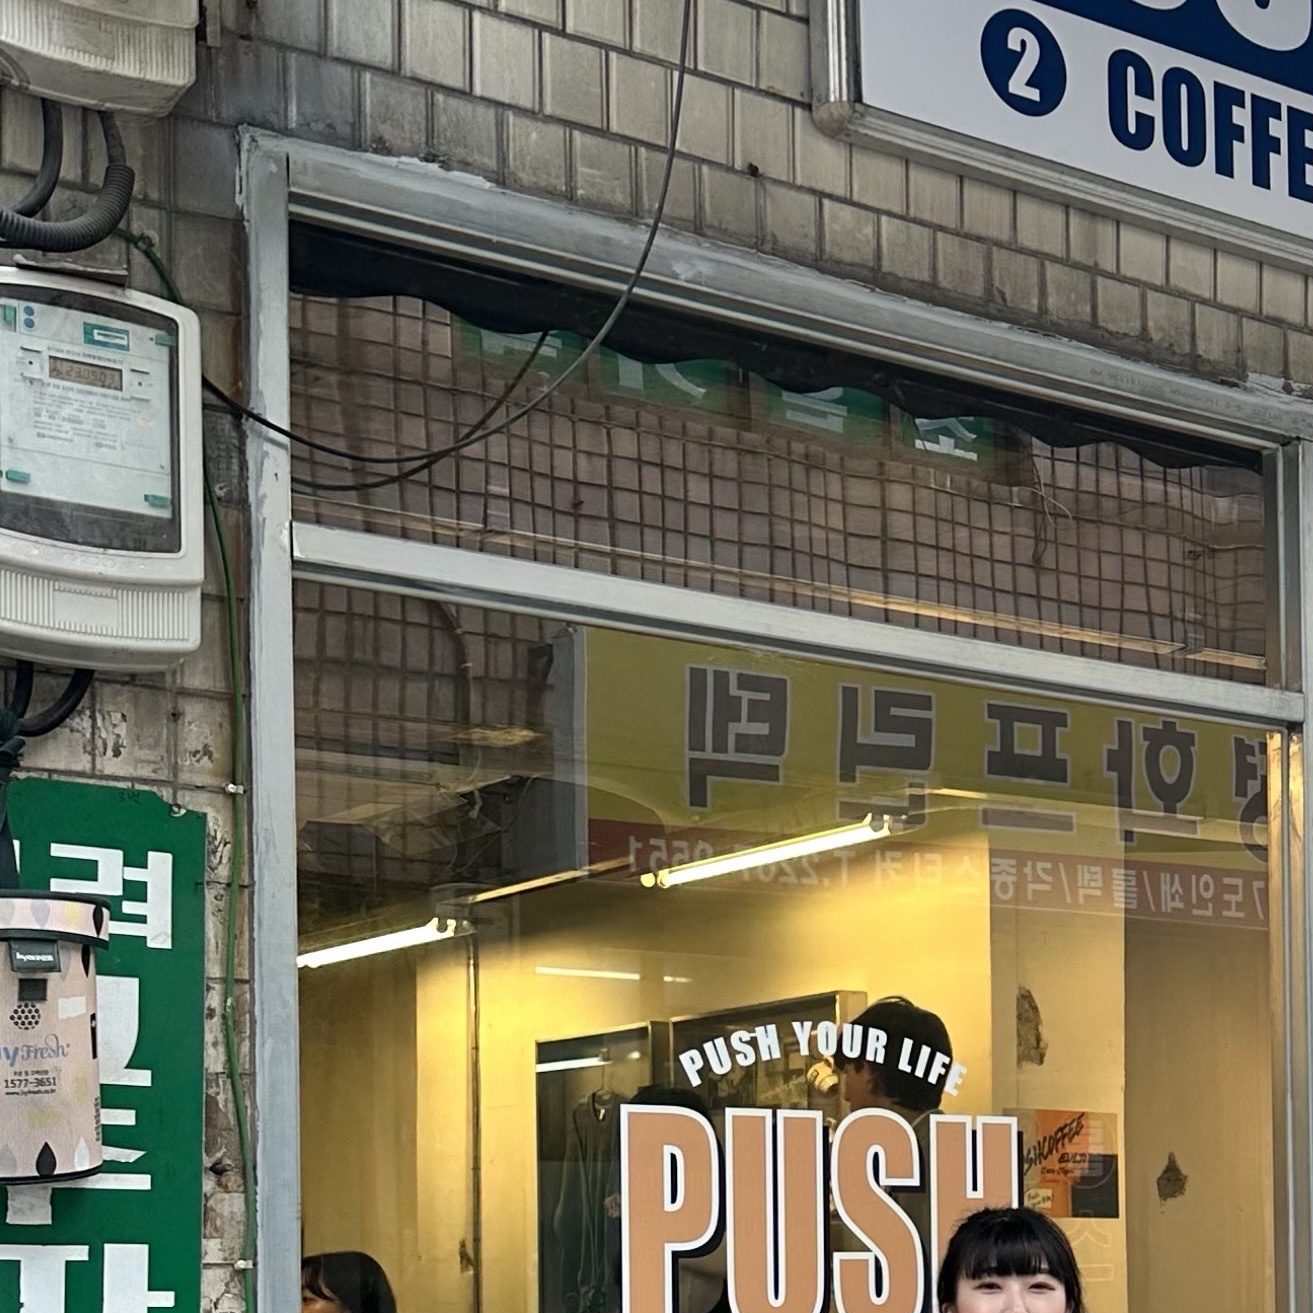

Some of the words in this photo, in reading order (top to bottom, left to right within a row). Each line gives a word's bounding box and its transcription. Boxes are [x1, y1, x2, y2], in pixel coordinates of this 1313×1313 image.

[678, 1022, 782, 1088] PUSH
[790, 1020, 889, 1064] YOUR
[897, 1037, 969, 1098] LIFE
